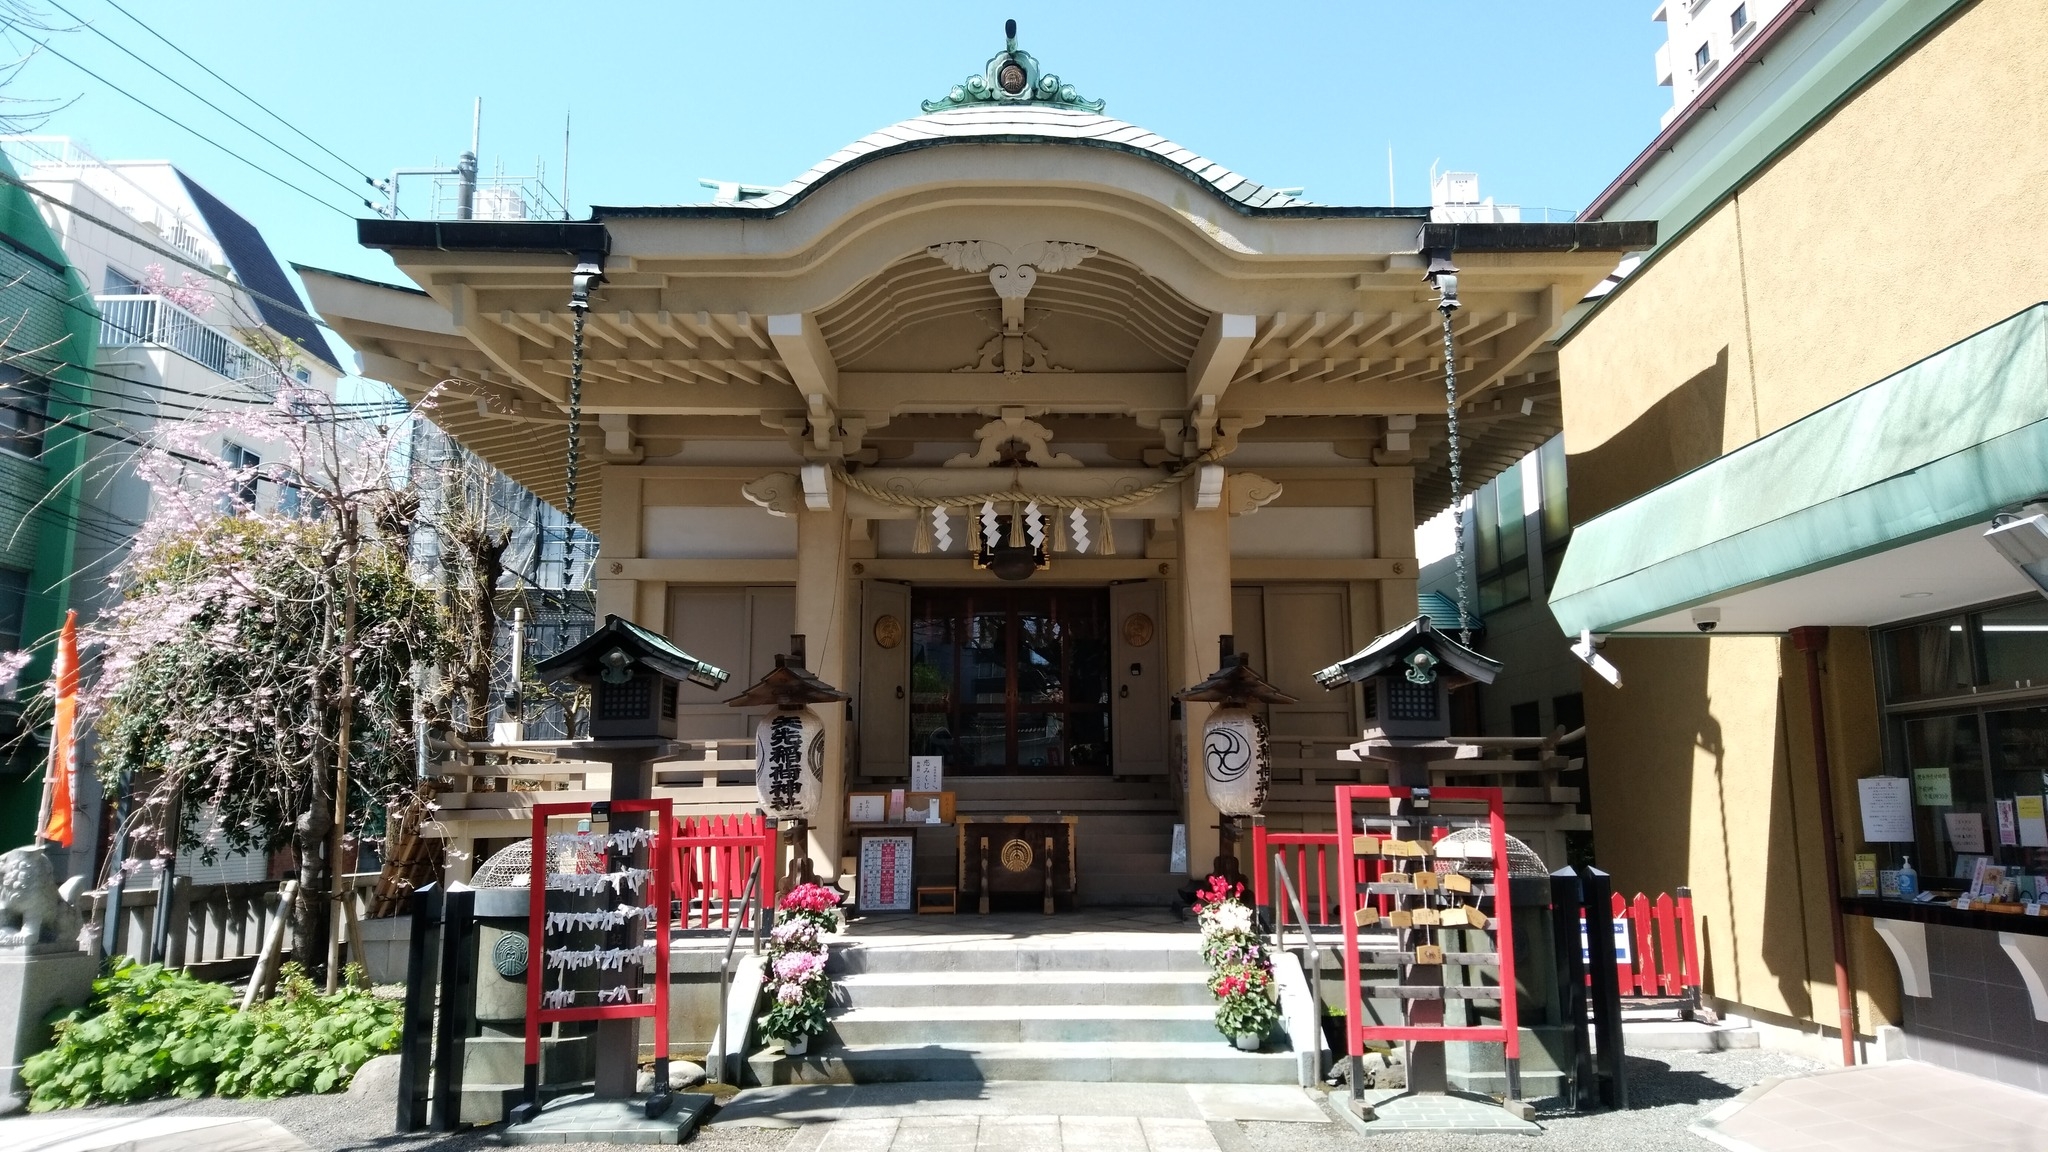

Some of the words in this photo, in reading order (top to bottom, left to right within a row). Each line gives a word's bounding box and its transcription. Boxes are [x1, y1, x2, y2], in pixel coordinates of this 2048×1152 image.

[768, 715, 804, 812] 矢先稲荷神社
